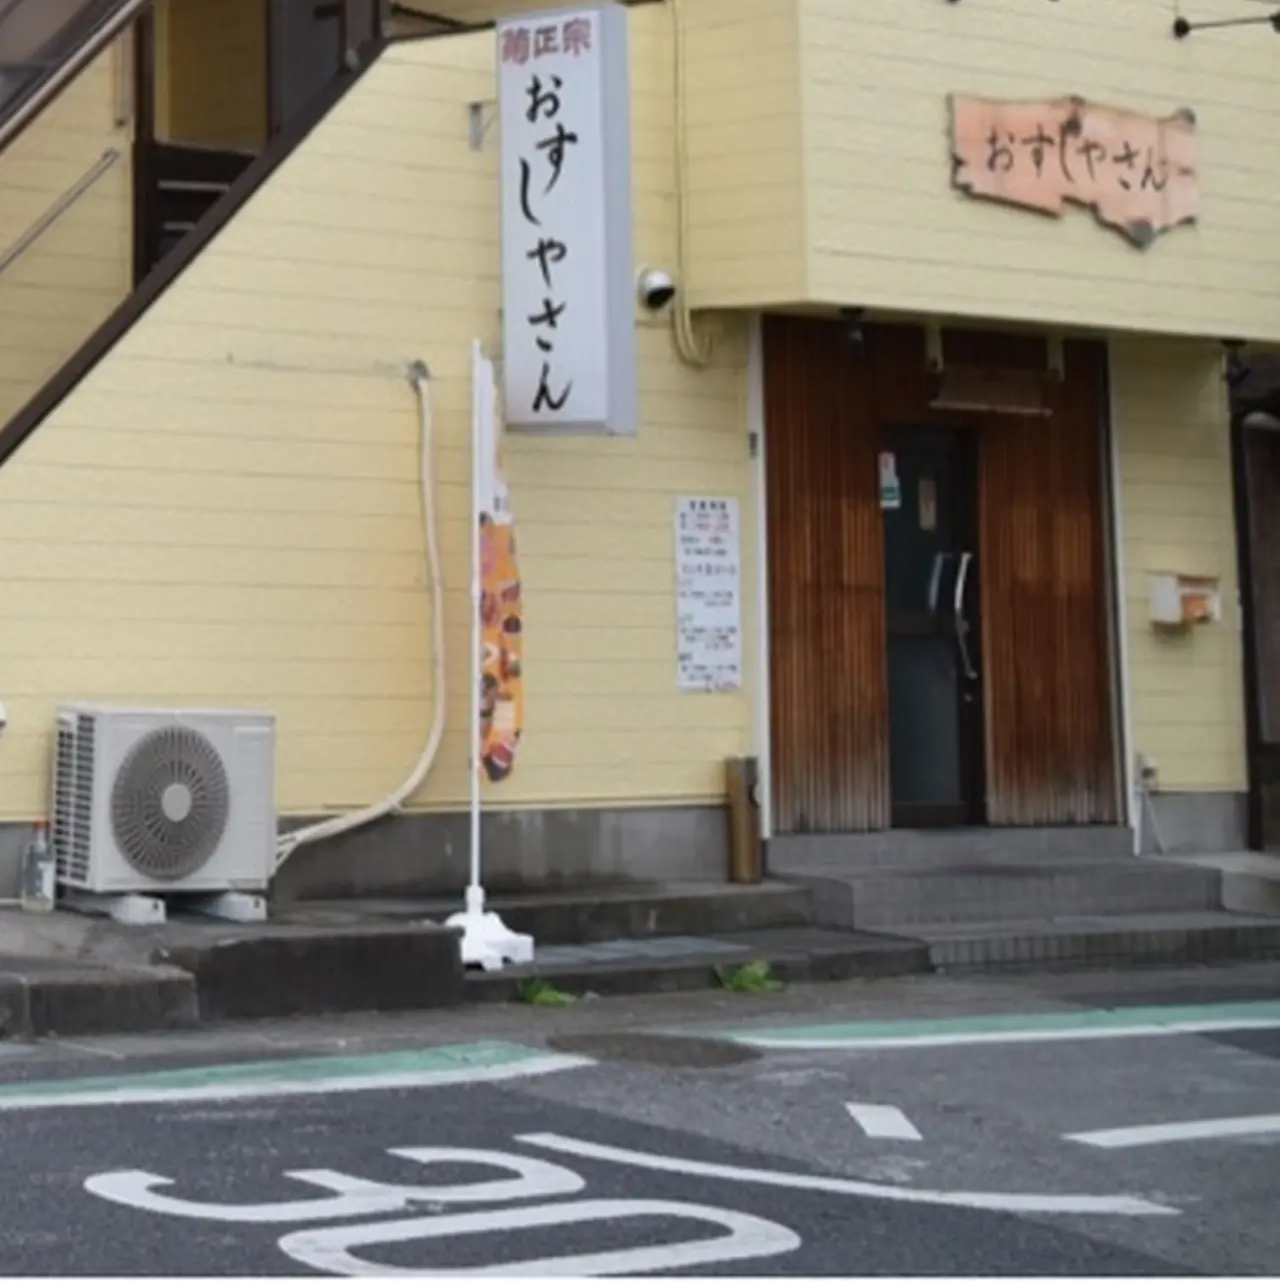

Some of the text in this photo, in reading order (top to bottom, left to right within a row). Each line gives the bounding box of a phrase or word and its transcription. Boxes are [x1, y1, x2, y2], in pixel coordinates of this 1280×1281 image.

[518, 73, 579, 414] おすしやさん
[986, 121, 1170, 193] おすしやさん
